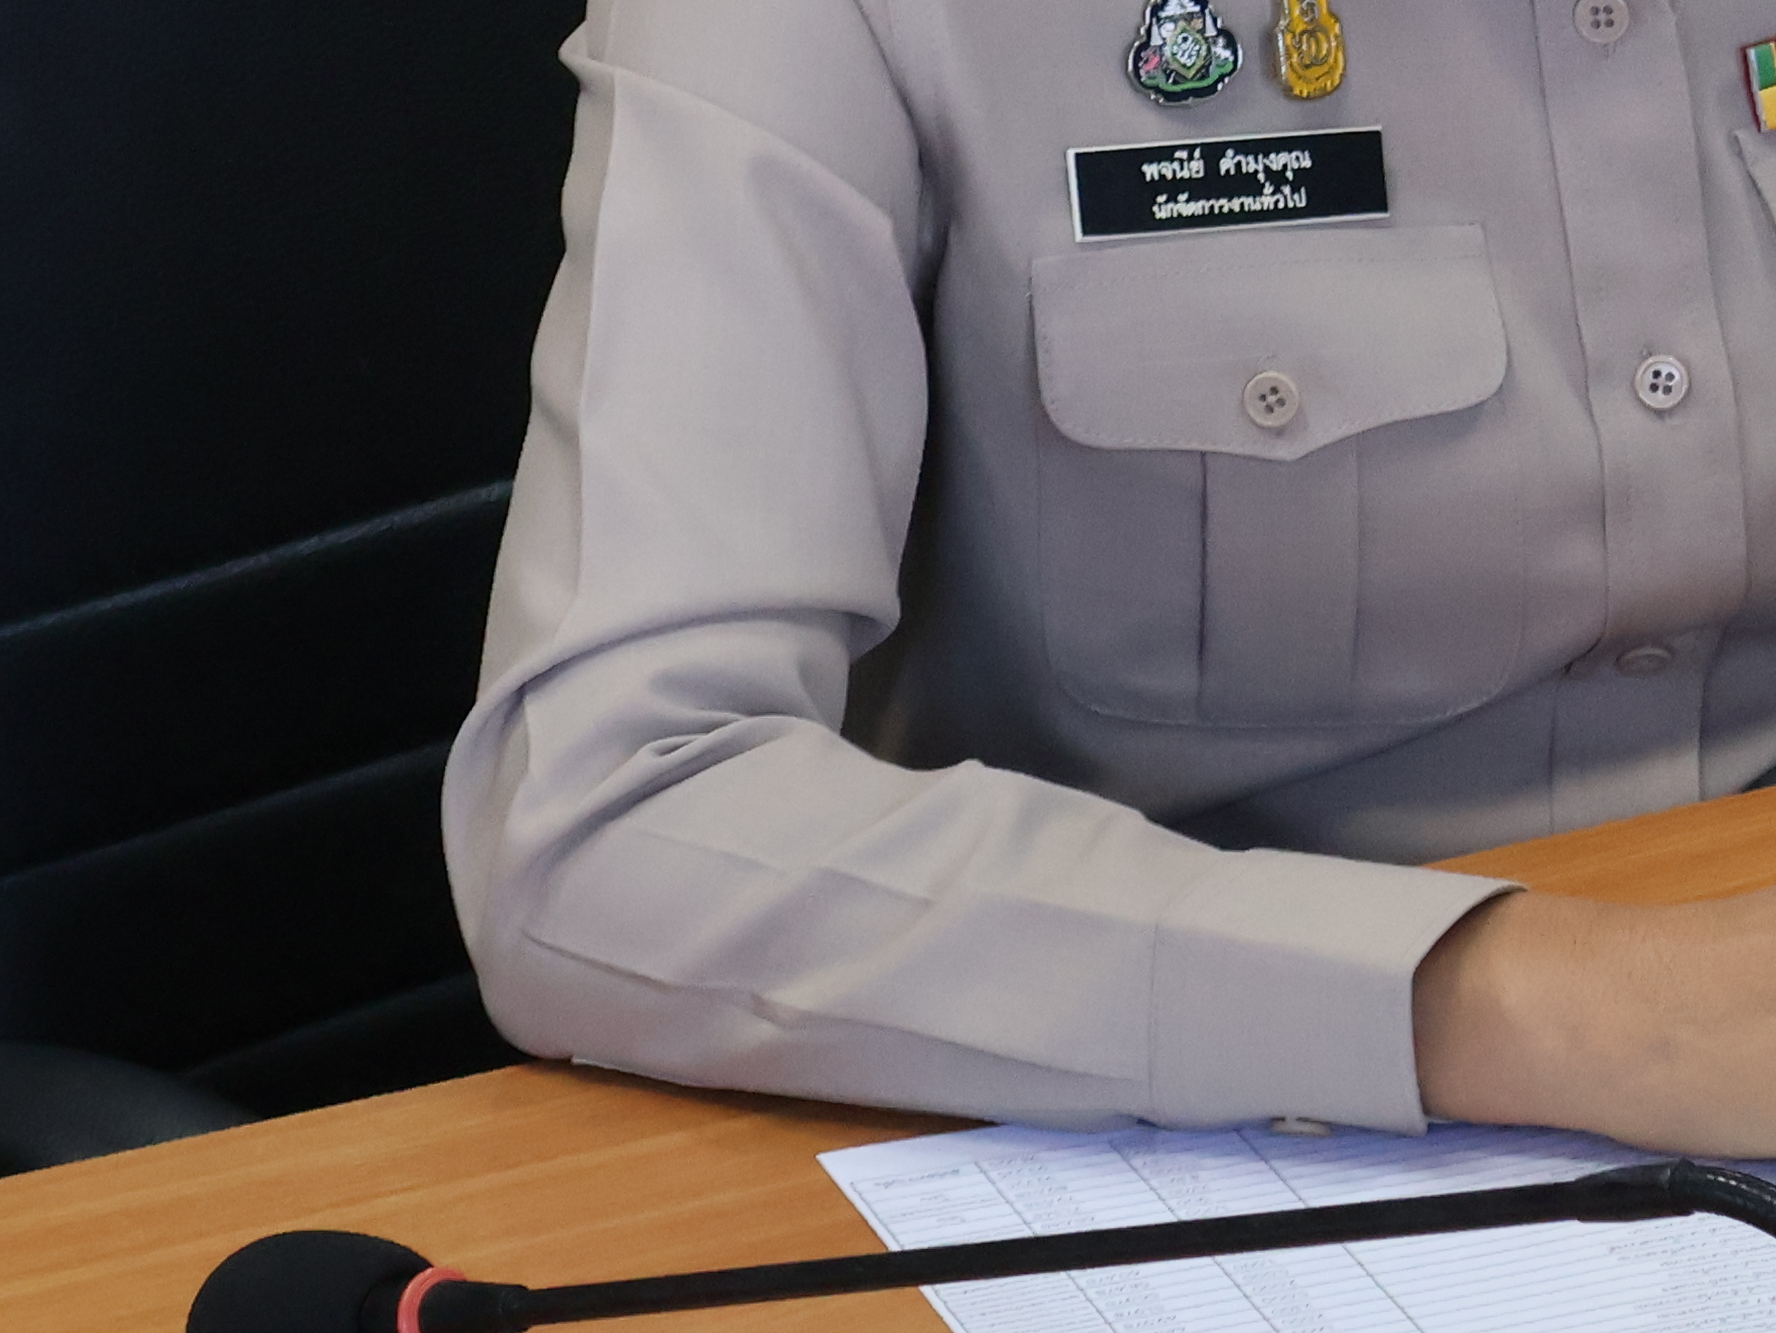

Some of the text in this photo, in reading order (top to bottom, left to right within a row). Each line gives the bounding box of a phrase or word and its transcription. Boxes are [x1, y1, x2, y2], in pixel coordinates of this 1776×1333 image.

[1152, 183, 1308, 220] นักจัดการงานทั่วไป
